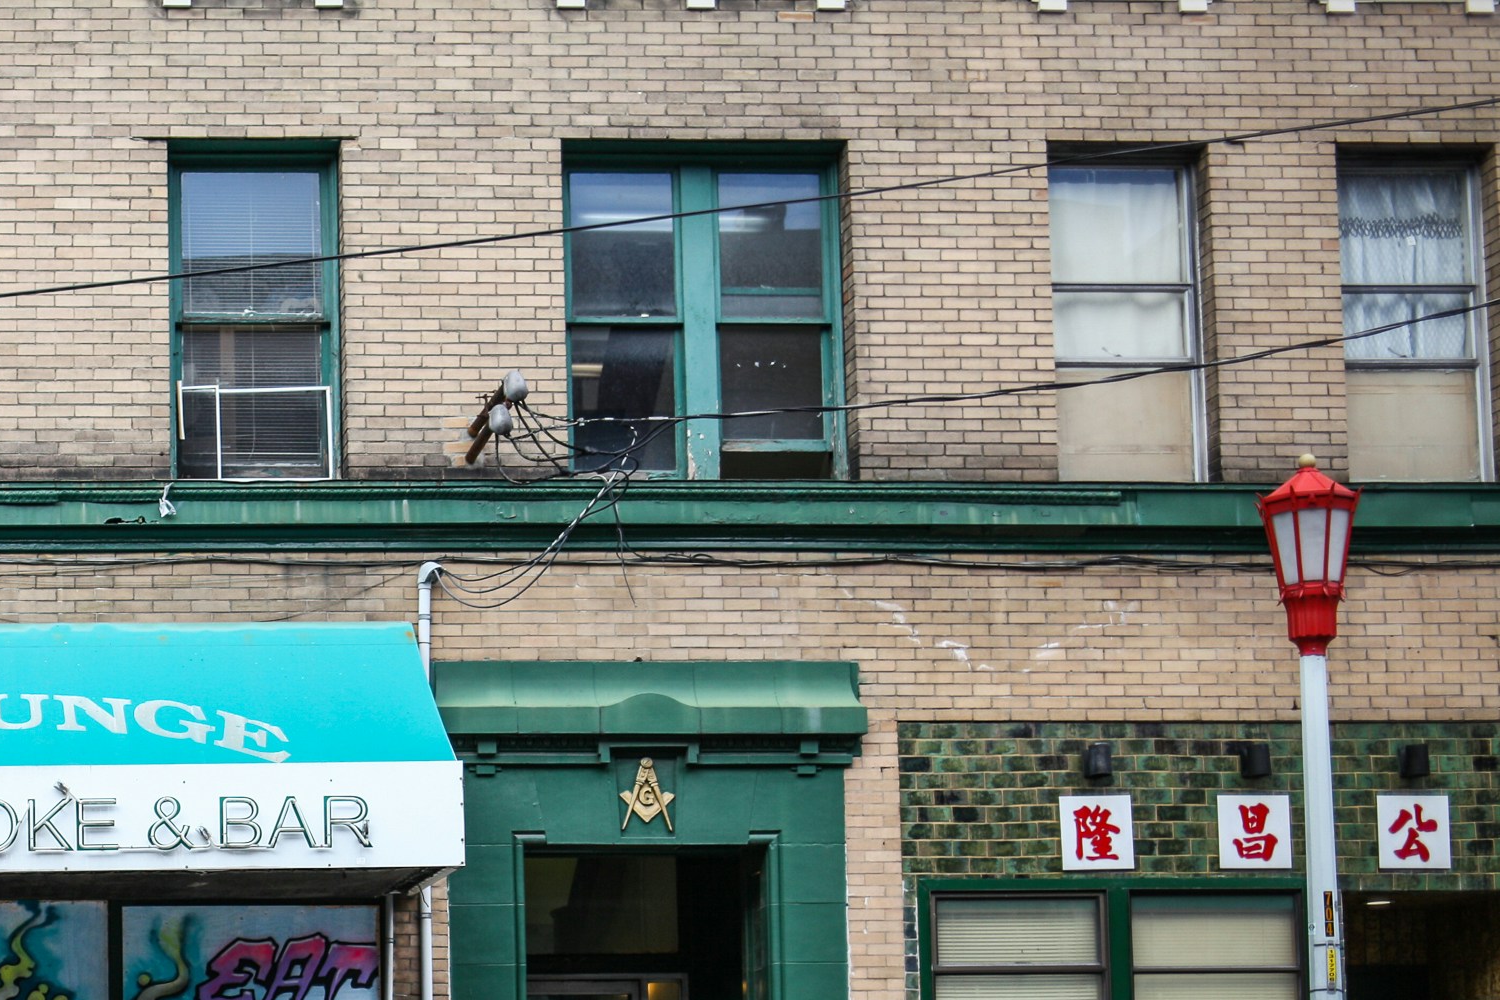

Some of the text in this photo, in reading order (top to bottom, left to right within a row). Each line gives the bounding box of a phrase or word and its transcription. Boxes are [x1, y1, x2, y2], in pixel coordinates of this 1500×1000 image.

[147, 796, 190, 850] &
[219, 796, 373, 849] BAR
[1324, 892, 1334, 936] 704
